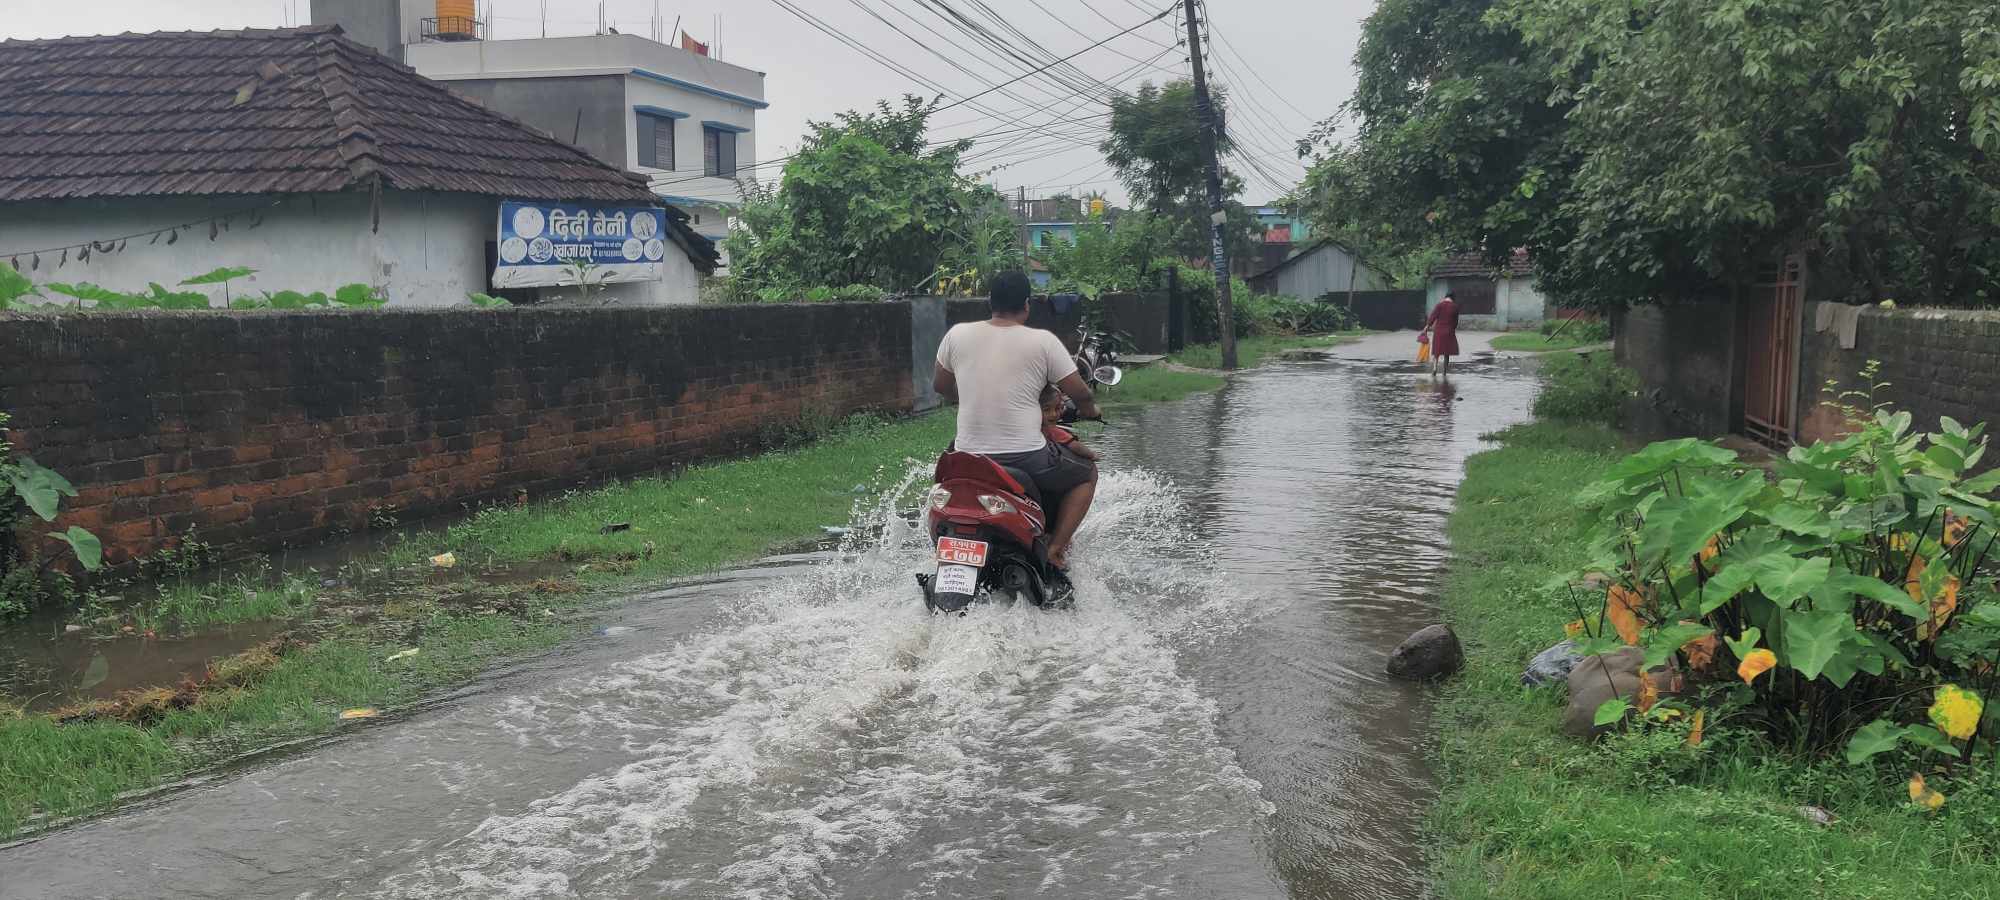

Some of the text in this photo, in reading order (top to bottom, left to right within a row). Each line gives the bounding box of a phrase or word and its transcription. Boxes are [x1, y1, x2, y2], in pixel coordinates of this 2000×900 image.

[549, 208, 627, 241] दिदी बैनी
[579, 244, 594, 262] घर
